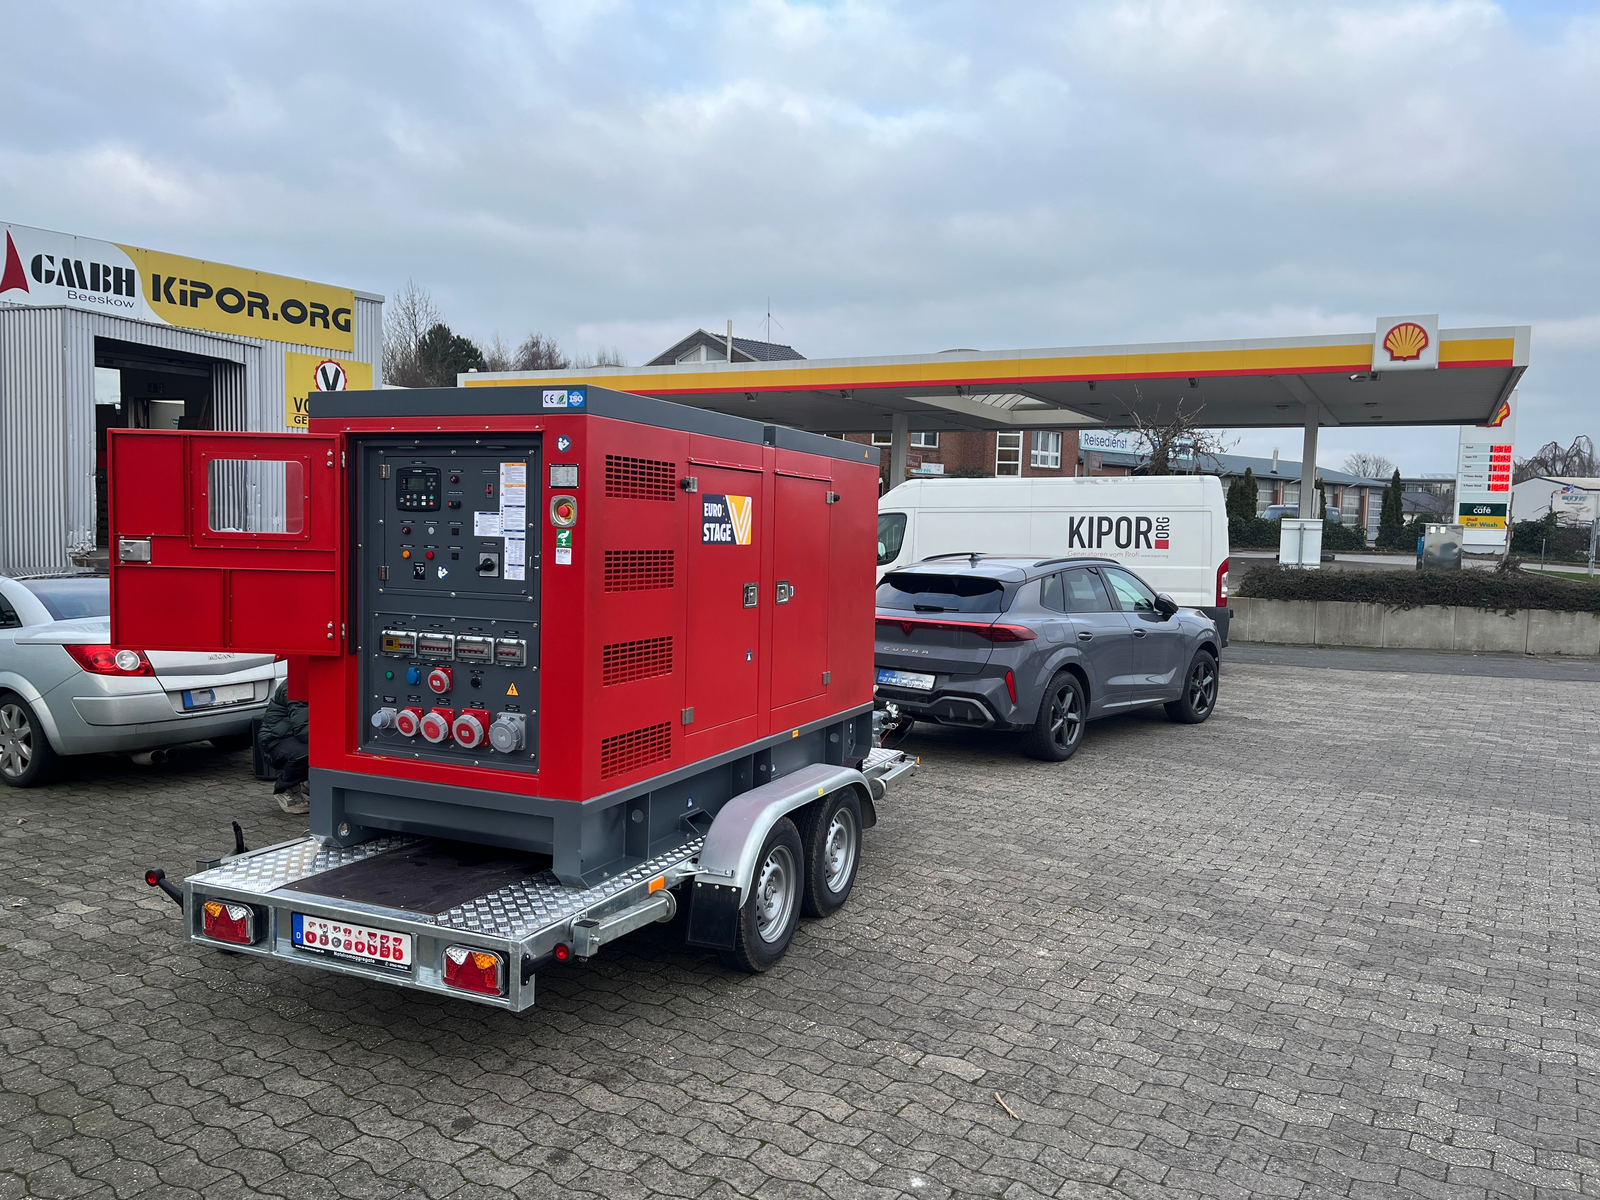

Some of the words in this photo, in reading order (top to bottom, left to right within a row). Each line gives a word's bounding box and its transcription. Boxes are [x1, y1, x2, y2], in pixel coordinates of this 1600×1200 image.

[31, 254, 135, 297] GMBH
[67, 290, 135, 308] Beeskow
[569, 395, 583, 403] ISO
[1084, 433, 1127, 449] Reisedienst
[704, 502, 722, 517] EURO
[703, 522, 731, 542] STAGE
[1068, 516, 1152, 549] KIPOR
[1155, 516, 1170, 539] ORG
[884, 646, 929, 654] CUPRA
